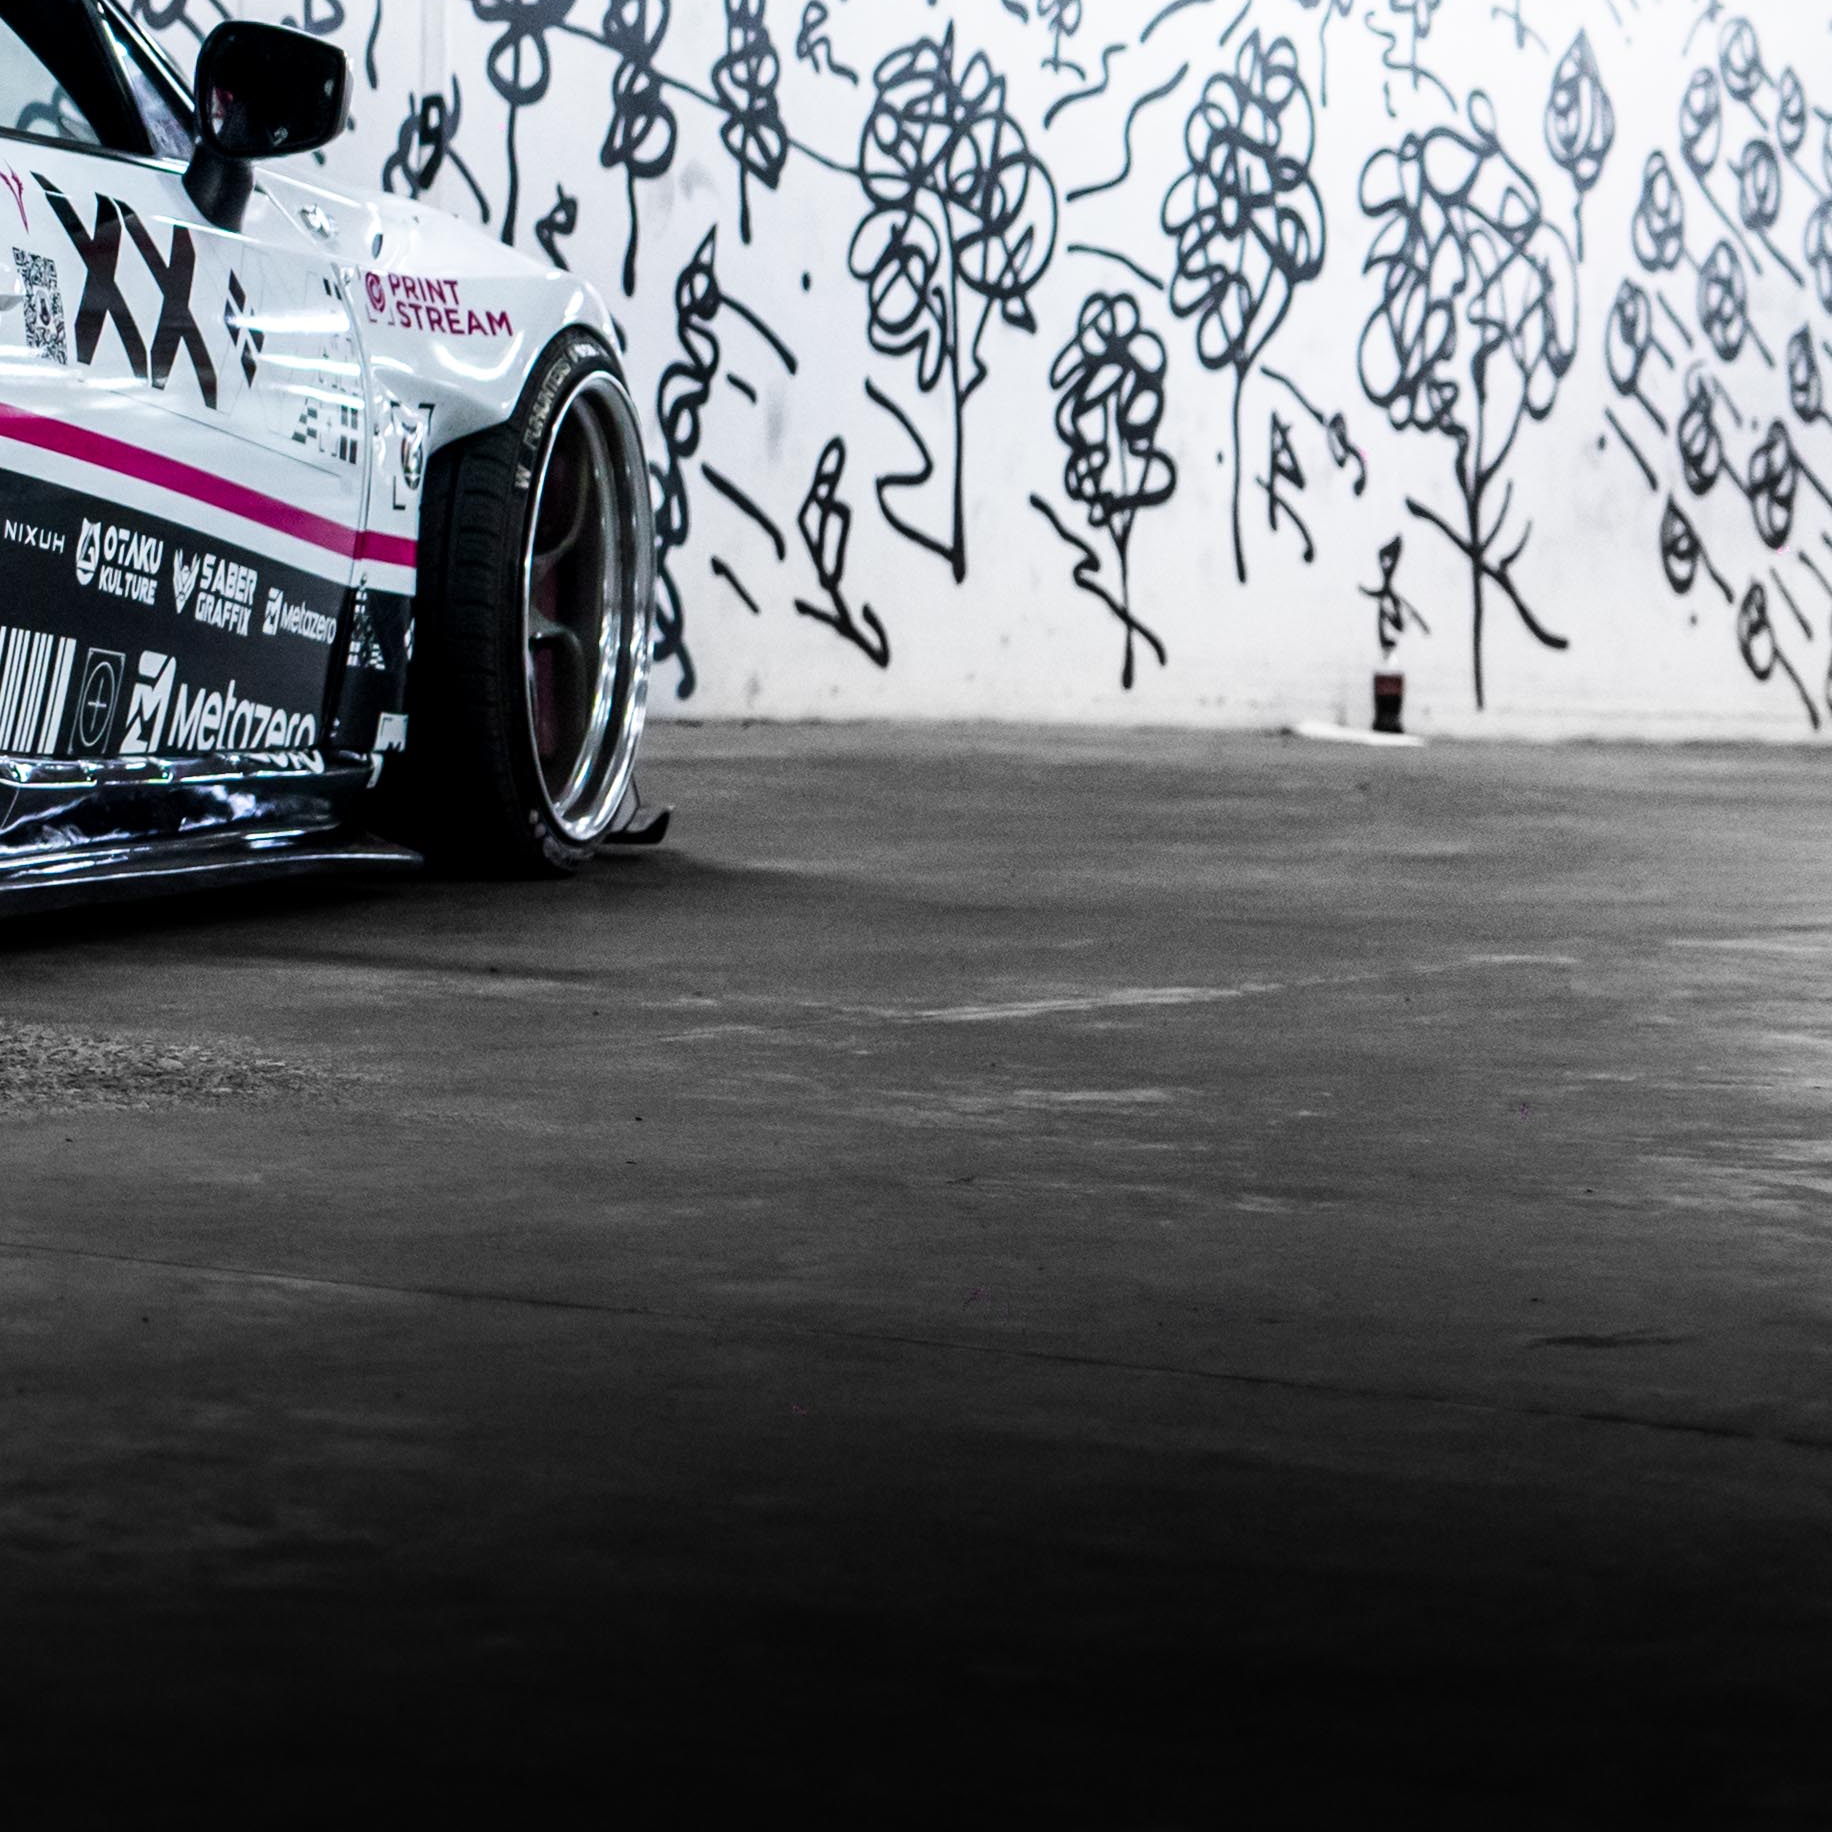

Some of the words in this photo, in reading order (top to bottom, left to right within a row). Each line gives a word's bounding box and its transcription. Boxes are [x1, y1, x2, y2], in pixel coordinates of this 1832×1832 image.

[389, 273, 460, 304] PRINT
[396, 301, 514, 336] STREAM
[4, 519, 65, 554] NIXUH
[104, 526, 164, 573] OTAKU
[98, 564, 158, 606] KULTURE
[200, 554, 258, 605] SABER
[194, 592, 253, 636] GRAFFIX
